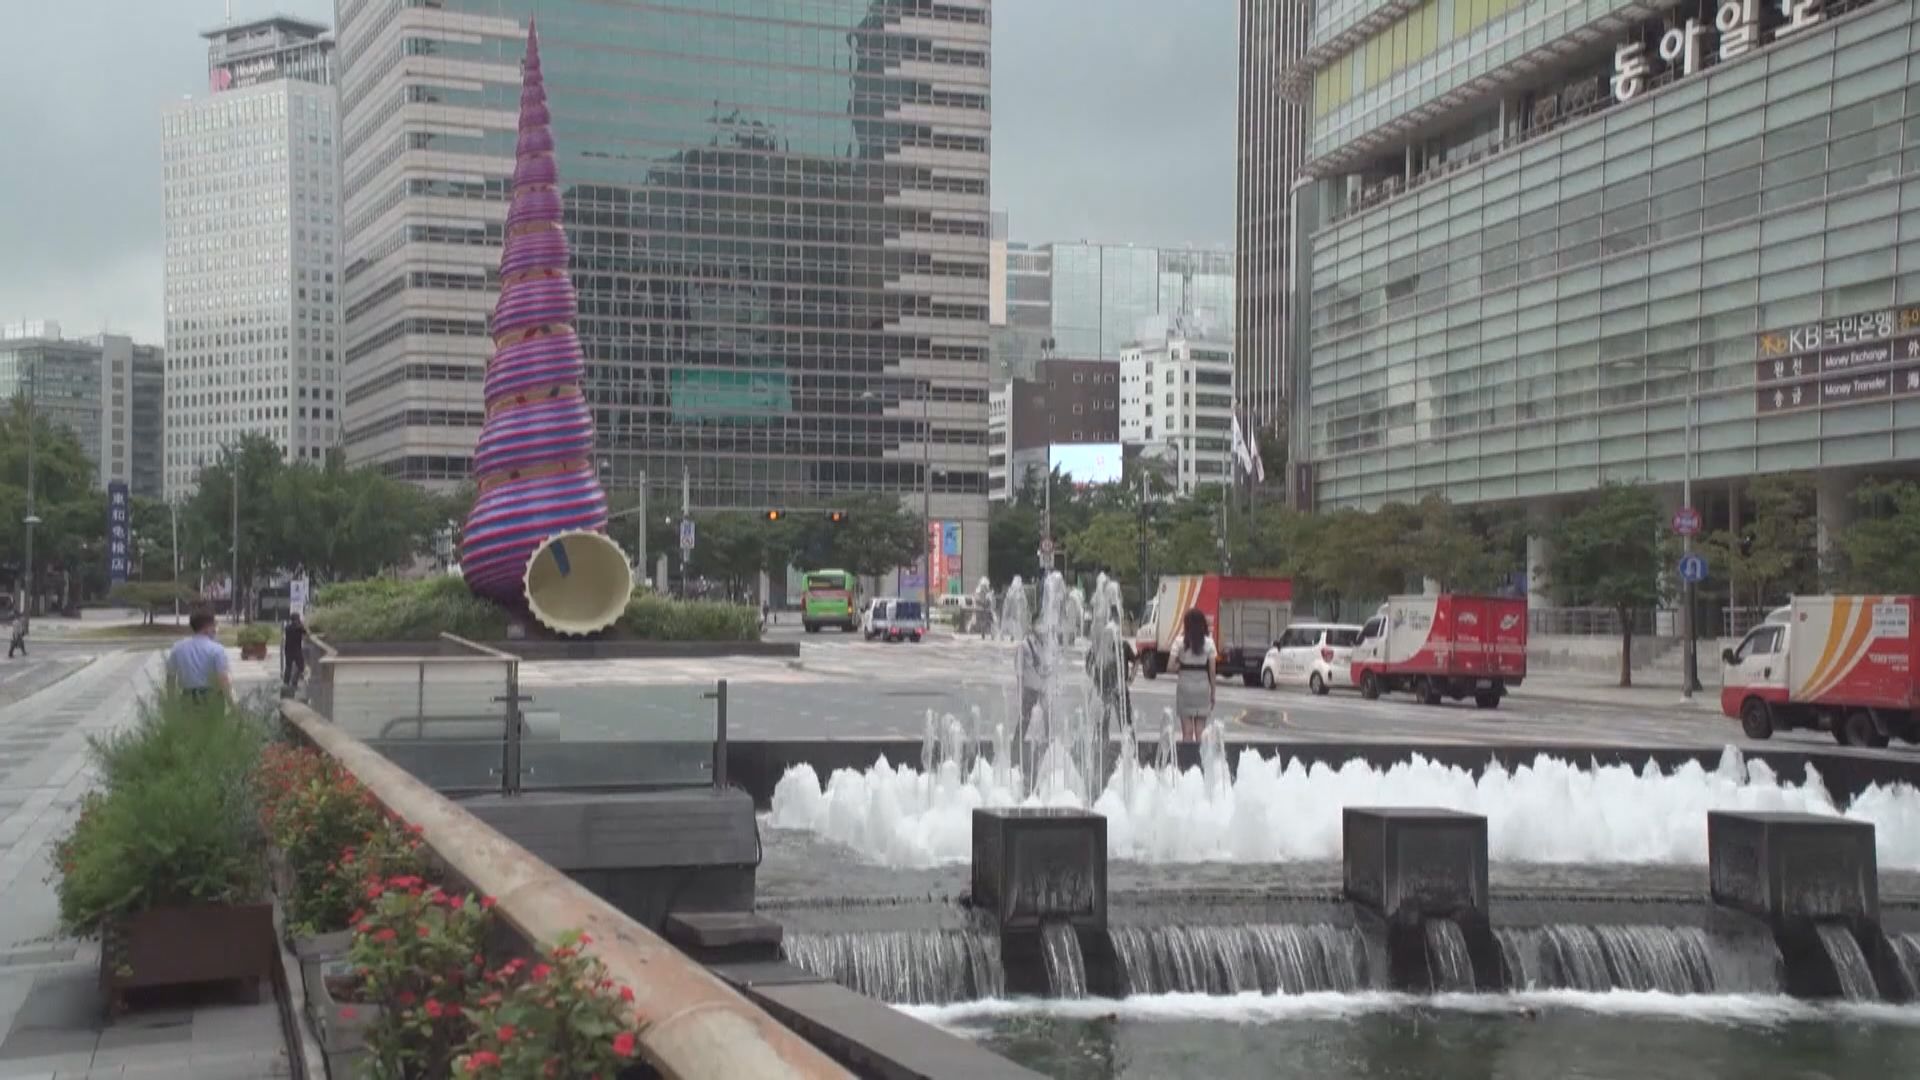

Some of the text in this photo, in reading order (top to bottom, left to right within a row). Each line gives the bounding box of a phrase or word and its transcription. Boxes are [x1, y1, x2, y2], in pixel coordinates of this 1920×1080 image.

[1825, 348, 1888, 368] Money Exchange
[1825, 382, 1851, 396] Money
